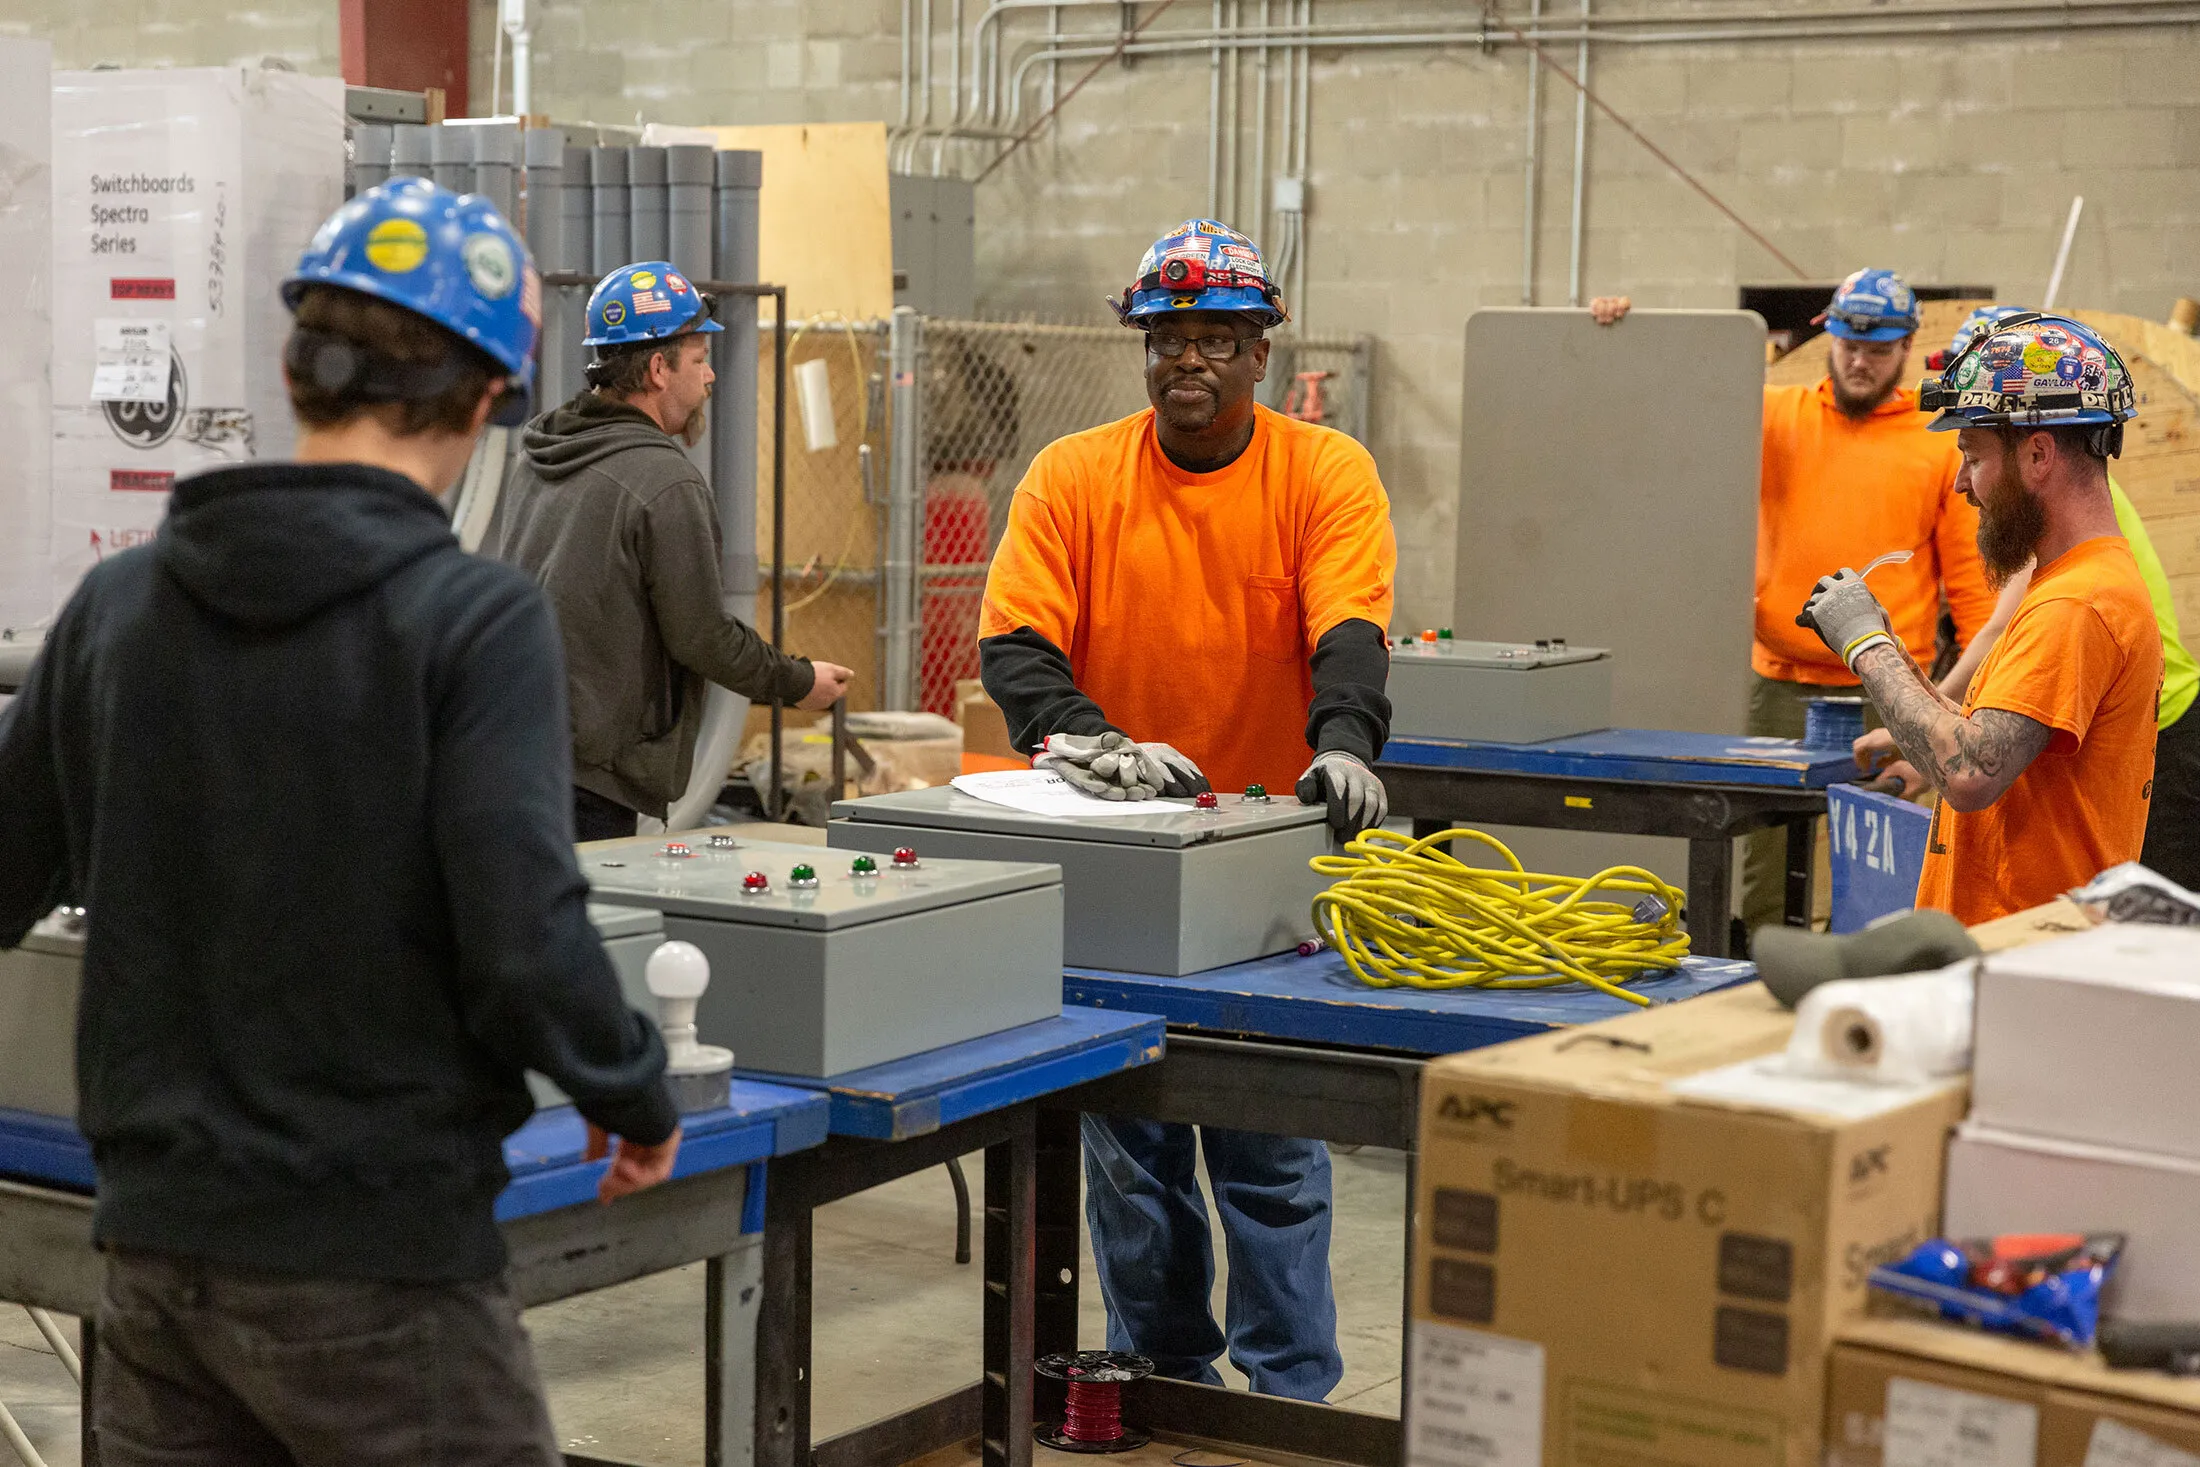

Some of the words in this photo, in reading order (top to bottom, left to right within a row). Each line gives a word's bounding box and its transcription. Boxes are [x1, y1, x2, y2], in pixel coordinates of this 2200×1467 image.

[90, 173, 195, 194] Switchboards
[90, 203, 149, 227] Spectra
[90, 232, 137, 254] Series
[2033, 378, 2075, 388] GAYLOR
[1829, 796, 1895, 875] Y42A
